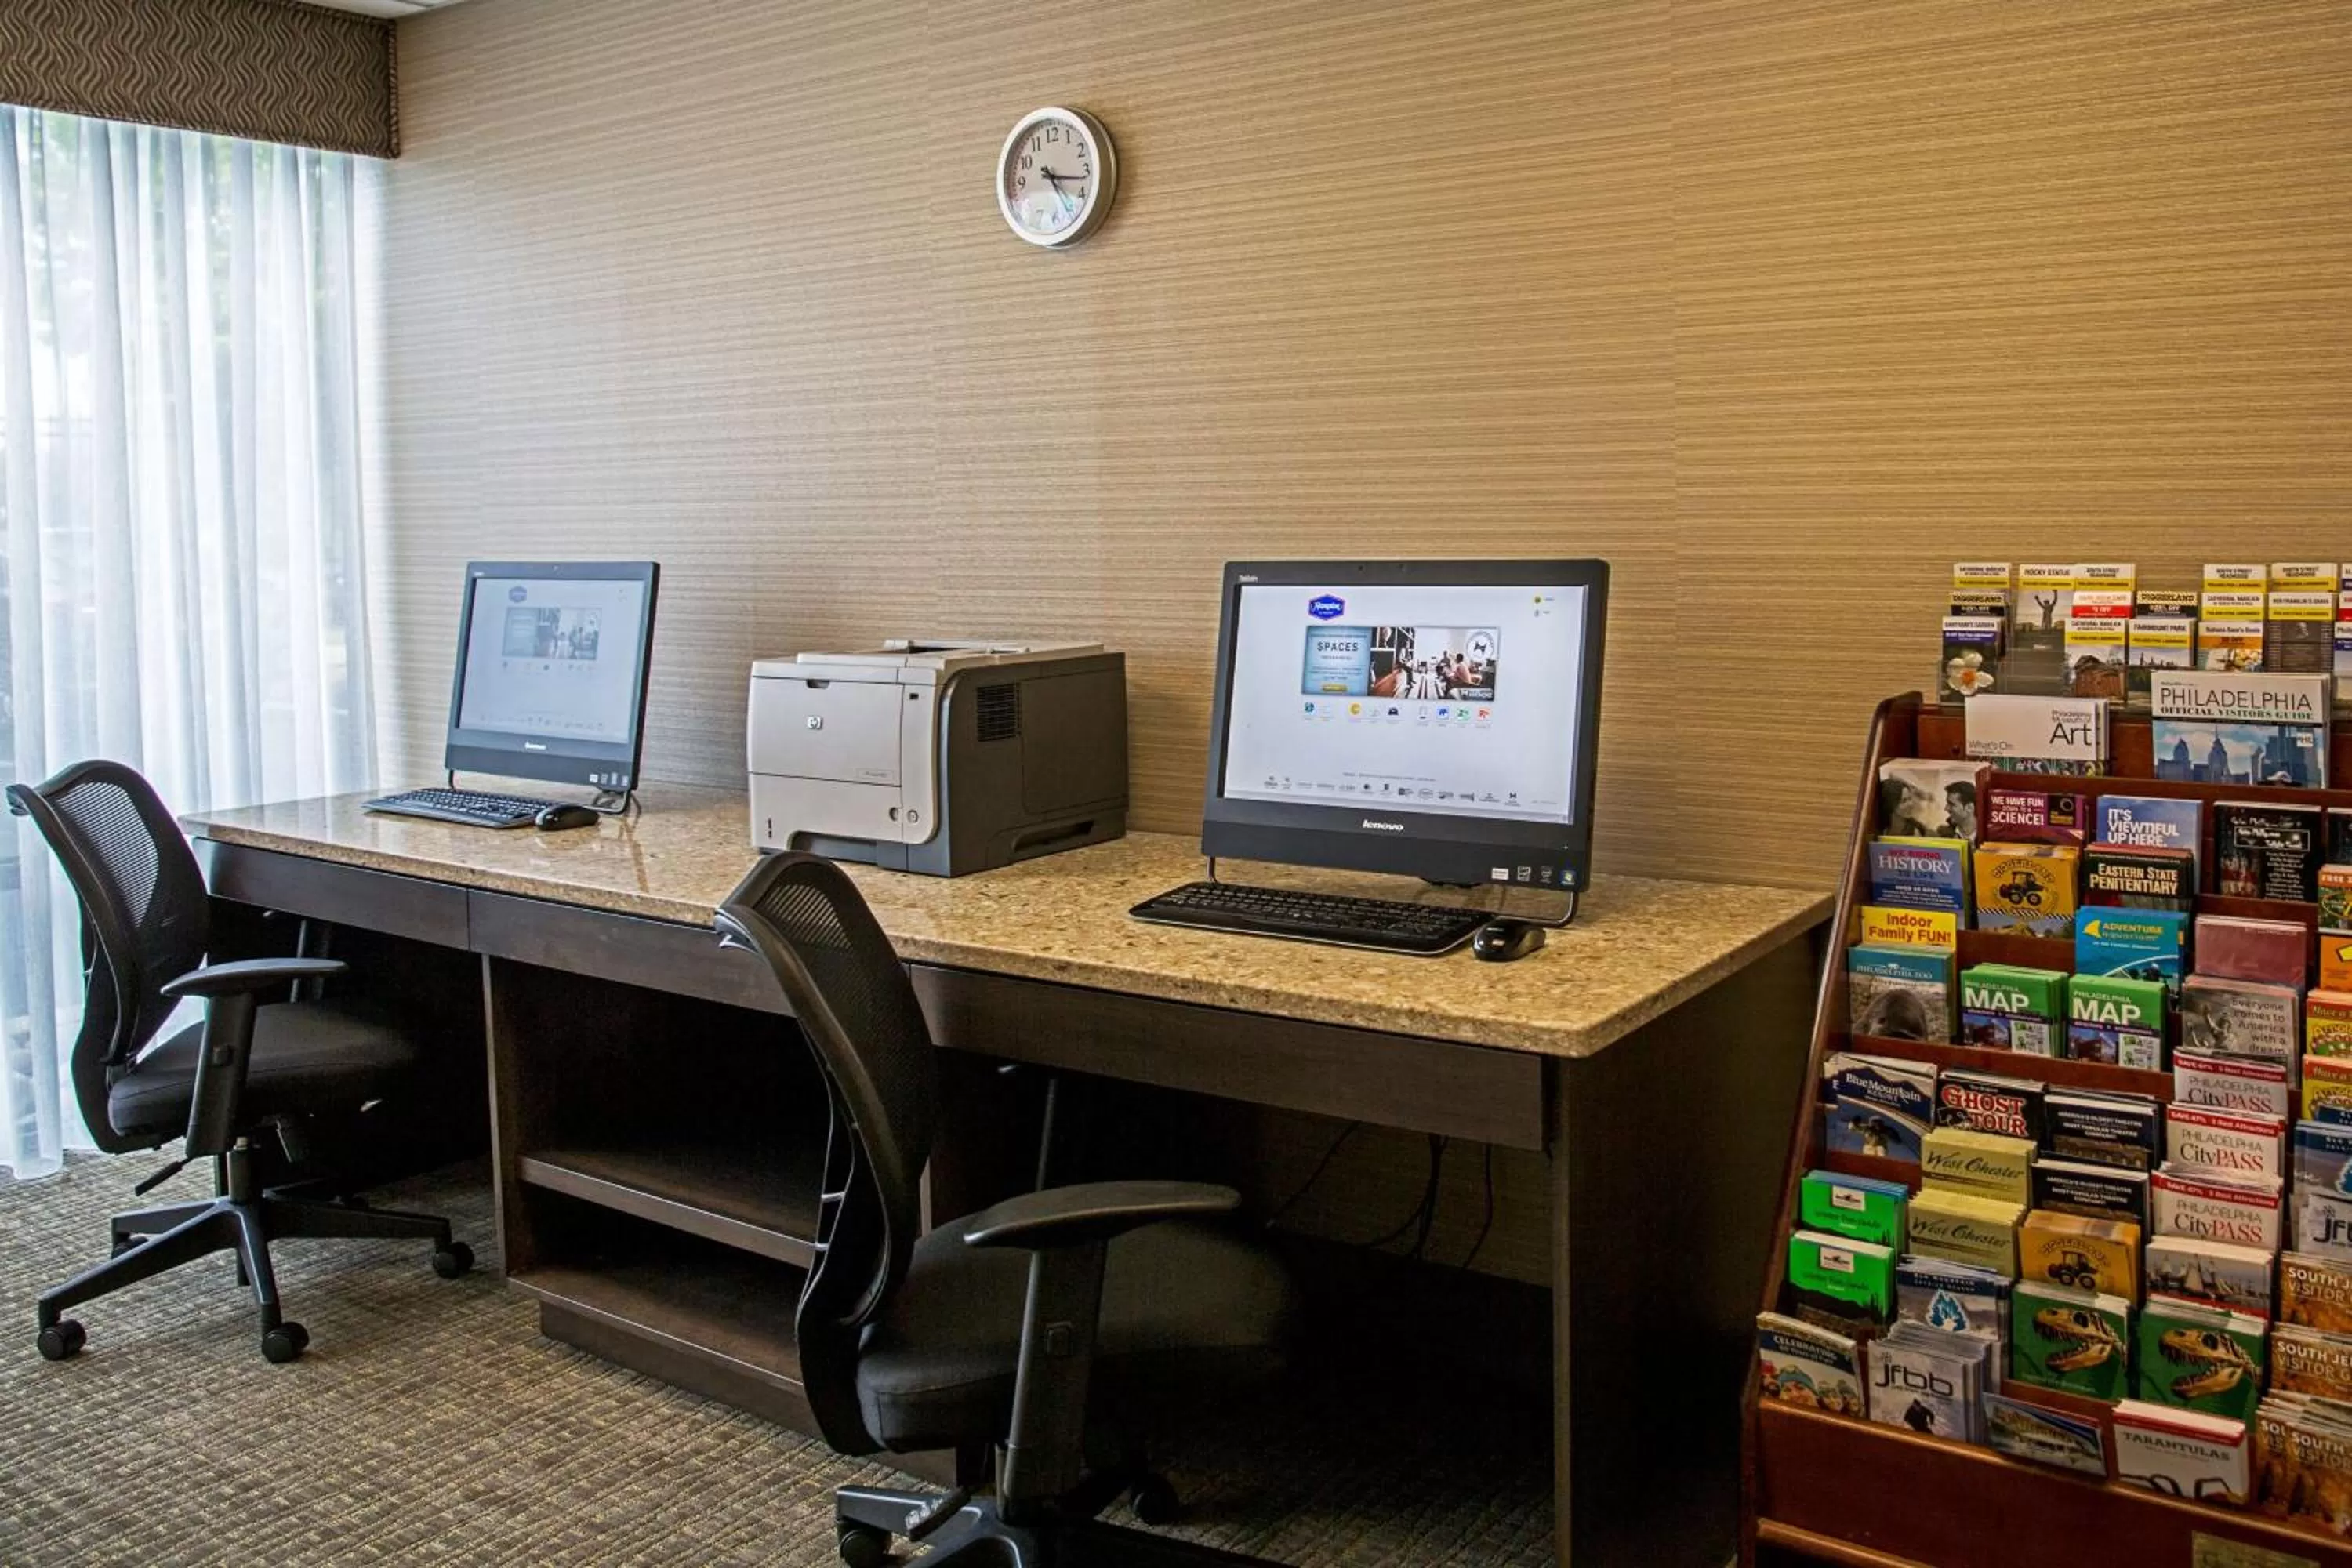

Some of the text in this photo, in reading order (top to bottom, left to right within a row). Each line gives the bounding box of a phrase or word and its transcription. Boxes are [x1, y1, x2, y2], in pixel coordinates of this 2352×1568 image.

[1045, 127, 1059, 143] 12
[1065, 129, 1072, 144] 1
[1031, 136, 1042, 153] 11
[1077, 143, 1086, 158] 2
[1021, 154, 1033, 170] 10
[1083, 162, 1091, 176] 3
[1017, 176, 1026, 191] 9
[1078, 186, 1087, 198] 4
[1317, 641, 1359, 652] SPACES
[2160, 687, 2312, 710] PHILADELPHIA
[2160, 706, 2313, 720] OFFICIAL VISITORS GUIDE
[2049, 722, 2092, 746] Art
[1991, 795, 2044, 807] WE HAVE FUN
[1991, 811, 2045, 826] SCIENCE!
[2107, 808, 2132, 821] IT'S
[1362, 818, 1404, 832] lenovo
[2107, 820, 2180, 837] VIEWTIFUL
[2107, 831, 2168, 848] UP HERE.
[1878, 855, 1954, 873] HISTORY
[1886, 913, 1933, 928] Indoor
[2102, 922, 2163, 935] ADVENTURE
[1868, 925, 1952, 942] Family FUN!
[1965, 987, 2030, 1014] MAP
[2072, 989, 2132, 1003] PHILADELPHIA
[2232, 997, 2284, 1011] Everyone
[2071, 996, 2141, 1025] MAP
[2273, 1013, 2285, 1022] to
[2238, 1020, 2285, 1033] America
[2251, 1033, 2276, 1044] with
[2188, 1075, 2271, 1096] PHILADELPHIA
[1941, 1083, 2027, 1115] GHOST
[2188, 1087, 2274, 1113] CityPASS
[1970, 1112, 2030, 1137] TOUR
[2182, 1128, 2263, 1152] PHILADELPHIA
[1926, 1149, 2025, 1178] West Chester
[2180, 1142, 2264, 1172] CityPASS
[2176, 1199, 2263, 1224] PHILADELPHIA
[1912, 1216, 2011, 1248] West Chester
[2174, 1212, 2263, 1243] CityPASS
[2288, 1266, 2339, 1287] SOUTH
[2288, 1279, 2345, 1302] VISITOR
[2277, 1341, 2328, 1363] SOUTH
[2276, 1353, 2335, 1380] VISITOR
[2122, 1431, 2230, 1461] TARANTULAS
[2291, 1431, 2345, 1455] SOUTH
